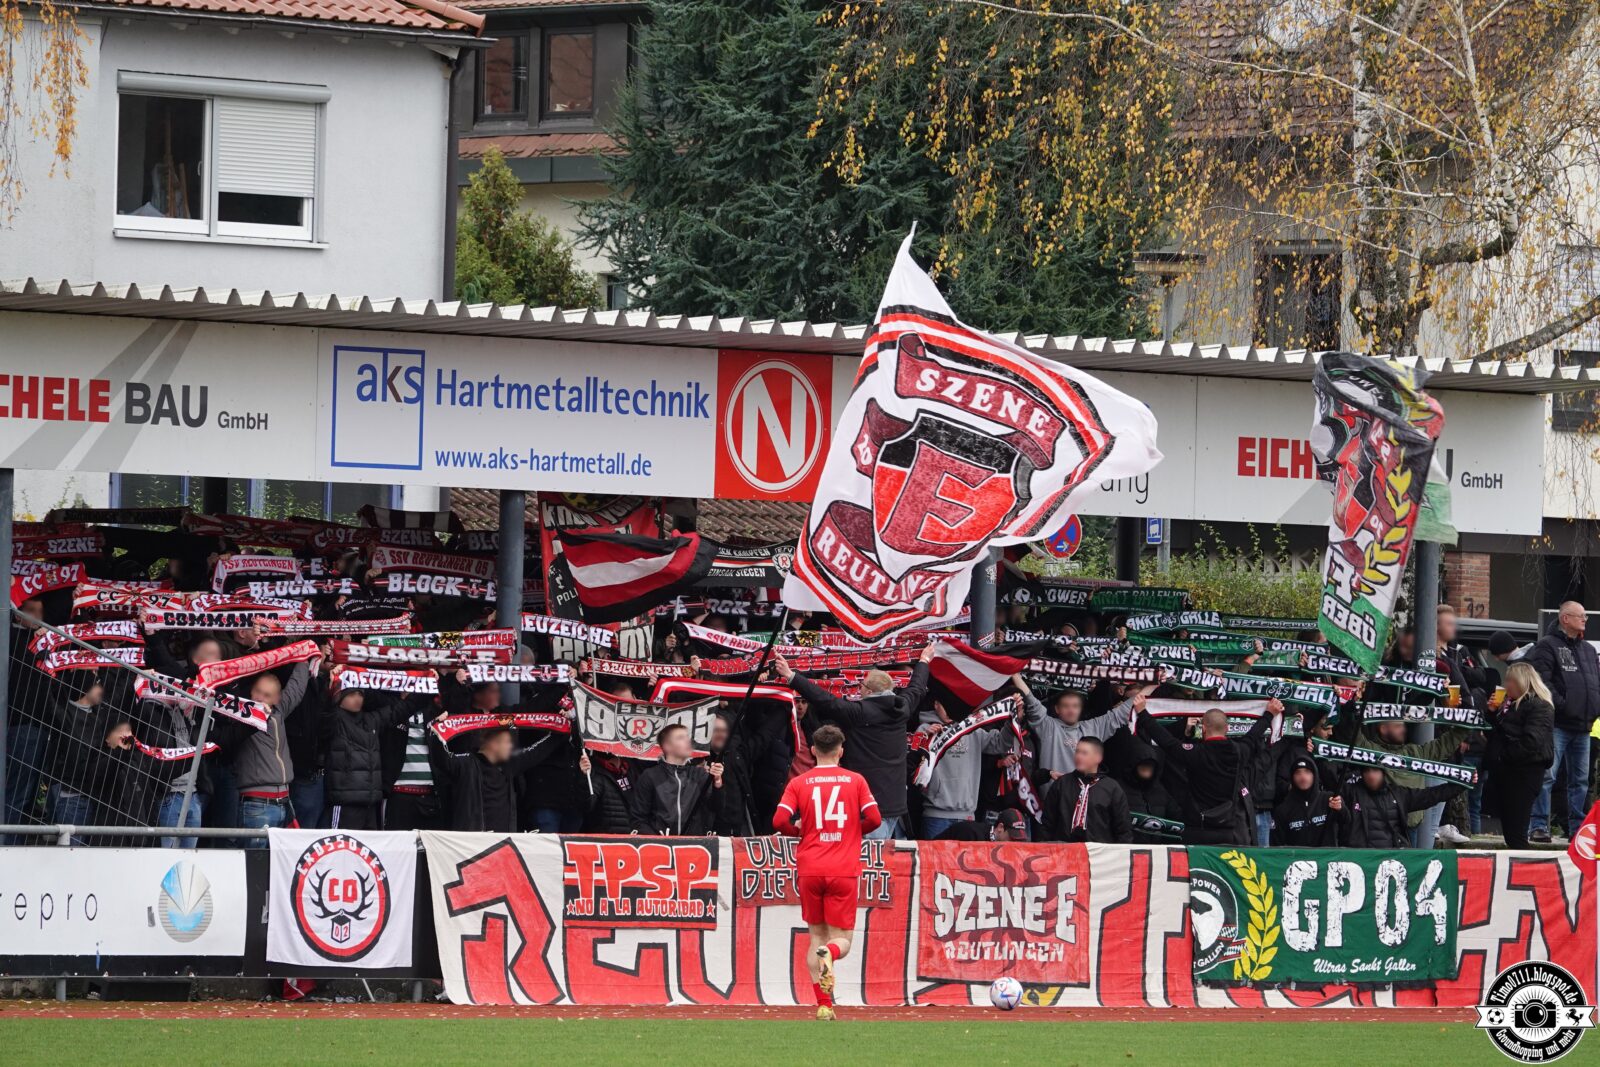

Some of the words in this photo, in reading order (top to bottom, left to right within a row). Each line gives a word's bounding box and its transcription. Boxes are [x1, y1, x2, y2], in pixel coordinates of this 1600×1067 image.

[356, 363, 424, 405] aks
[436, 367, 711, 419] Hartmetalltechnik
[125, 382, 208, 428] BAU
[217, 411, 269, 430] GmbH
[915, 368, 1052, 437] SZENE
[435, 446, 653, 477] www.aks-hartmetall.de
[1237, 436, 1321, 480] EICH
[1460, 472, 1503, 490] GmbH
[47, 536, 97, 554] SZENE
[380, 529, 433, 547] SZENE
[241, 557, 294, 571] REUTLINGEN
[389, 549, 410, 565] SSV
[411, 551, 474, 572] REUTLINGEN
[474, 559, 489, 576] 05
[735, 567, 766, 578] SIEGEN
[21, 572, 43, 594] CC
[60, 563, 81, 584] 97
[248, 579, 318, 598] BLOCK
[338, 577, 354, 595] E
[387, 572, 464, 597] BLOCK
[97, 590, 120, 602] CC
[148, 593, 171, 608] 97
[706, 598, 751, 615] OCK
[1046, 588, 1088, 606] OWER
[94, 619, 138, 639] SZENE
[521, 614, 614, 648] EUZEICHE
[1126, 613, 1163, 632] ANKT
[1179, 611, 1223, 628] GALLE
[347, 643, 453, 667] BLOCK
[1307, 656, 1360, 675] GREEN
[467, 664, 537, 684] BLOCK
[556, 663, 570, 683] E
[1181, 667, 1222, 690] POW
[1292, 686, 1338, 707] GALL
[620, 702, 665, 716] SSV
[1363, 702, 1403, 719] REEN
[631, 718, 647, 736] R
[1410, 759, 1473, 784] POWER
[811, 785, 848, 830] 14
[296, 834, 387, 881] CROSSOAKS
[564, 841, 712, 902] TPSP
[328, 878, 358, 903] CO
[0, 892, 98, 930] epro
[574, 898, 595, 916] NO
[599, 897, 609, 916] A
[614, 897, 632, 916] LA
[635, 898, 705, 918] AUTORIDAD
[932, 871, 1049, 939] SZENE
[1055, 875, 1078, 945] E
[1281, 858, 1449, 953] GP04
[944, 940, 1065, 963] REUTLINGEN
[1197, 941, 1225, 968] GALLEN
[1312, 957, 1348, 974] Ultras
[1349, 956, 1383, 974] Sankt
[1384, 956, 1417, 976] Gallen
